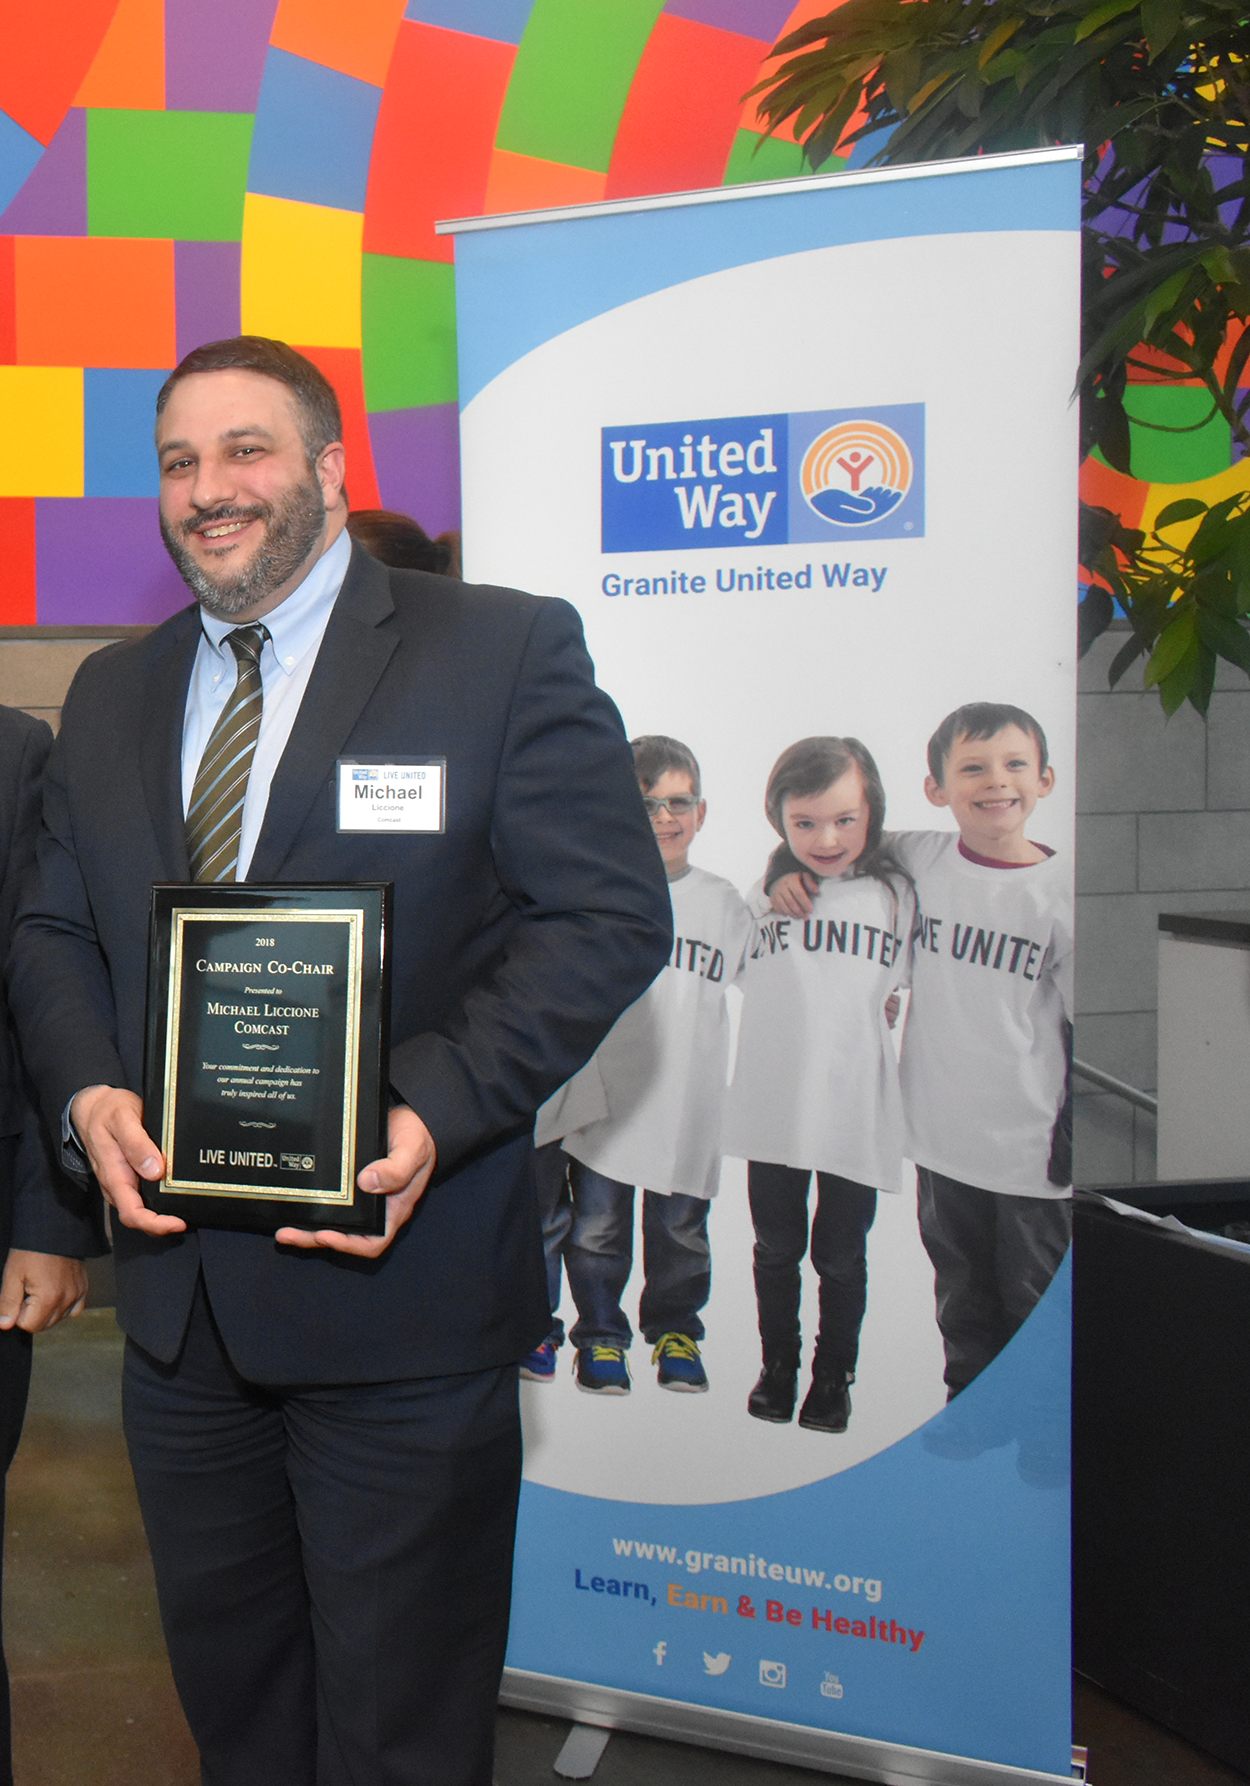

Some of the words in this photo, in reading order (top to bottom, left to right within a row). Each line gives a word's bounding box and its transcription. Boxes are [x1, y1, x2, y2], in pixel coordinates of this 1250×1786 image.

[610, 428, 777, 483] United
[674, 484, 777, 538] Way
[602, 571, 706, 596] Granite
[716, 564, 812, 592] United
[822, 563, 888, 592] Way
[383, 771, 398, 779] LIVE
[401, 771, 426, 780] UNITED
[354, 784, 422, 799] Michael
[255, 938, 275, 947] 2018
[196, 959, 262, 973] CAMPAIGN
[268, 961, 334, 975] CO-CHAIR
[244, 986, 274, 995] Presented
[207, 1002, 260, 1016] MICHAEL
[264, 1004, 319, 1018] LICCIONE
[234, 1021, 289, 1036] COMCAST
[202, 1062, 217, 1070] Your
[275, 1065, 311, 1074] dedication
[255, 1079, 289, 1087] campaign
[221, 1089, 238, 1098] truly
[239, 1090, 266, 1099] inspired
[278, 1091, 287, 1100] of
[200, 1149, 225, 1165] LIVE
[613, 1538, 882, 1602] www.graniteuw.org
[575, 1569, 656, 1605] Learn,
[667, 1583, 728, 1614] Earn
[736, 1595, 756, 1618] &
[765, 1600, 802, 1626] Be
[812, 1608, 925, 1652] Healthy
